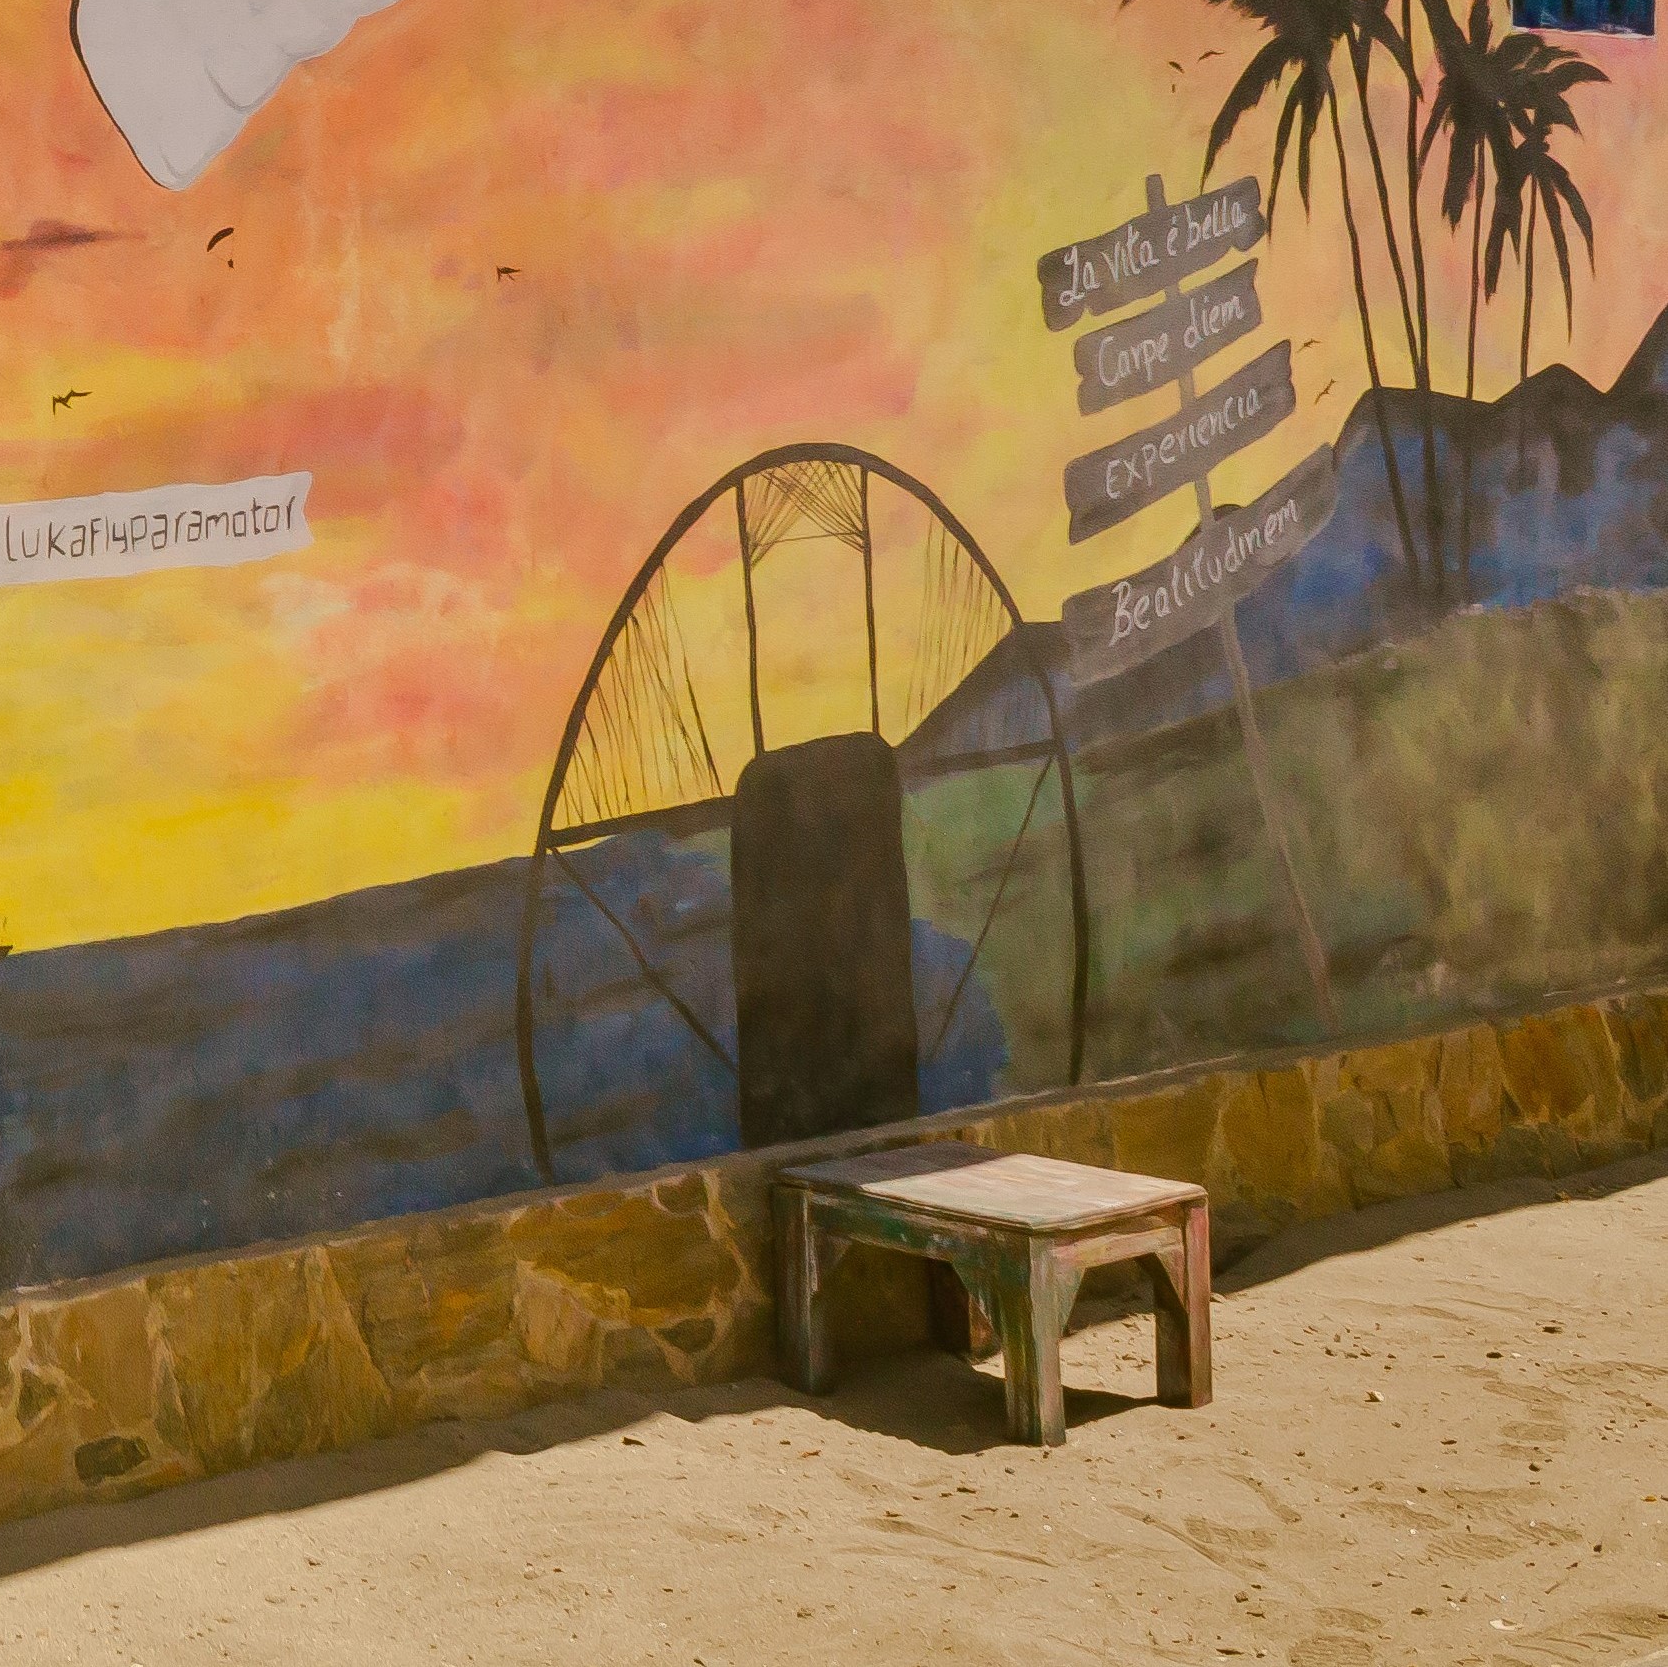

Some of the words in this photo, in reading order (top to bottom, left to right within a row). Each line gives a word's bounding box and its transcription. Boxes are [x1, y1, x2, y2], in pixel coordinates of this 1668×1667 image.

[1184, 196, 1248, 253] bella
[1098, 335, 1168, 387] Carpe
[1183, 295, 1245, 349] diem
